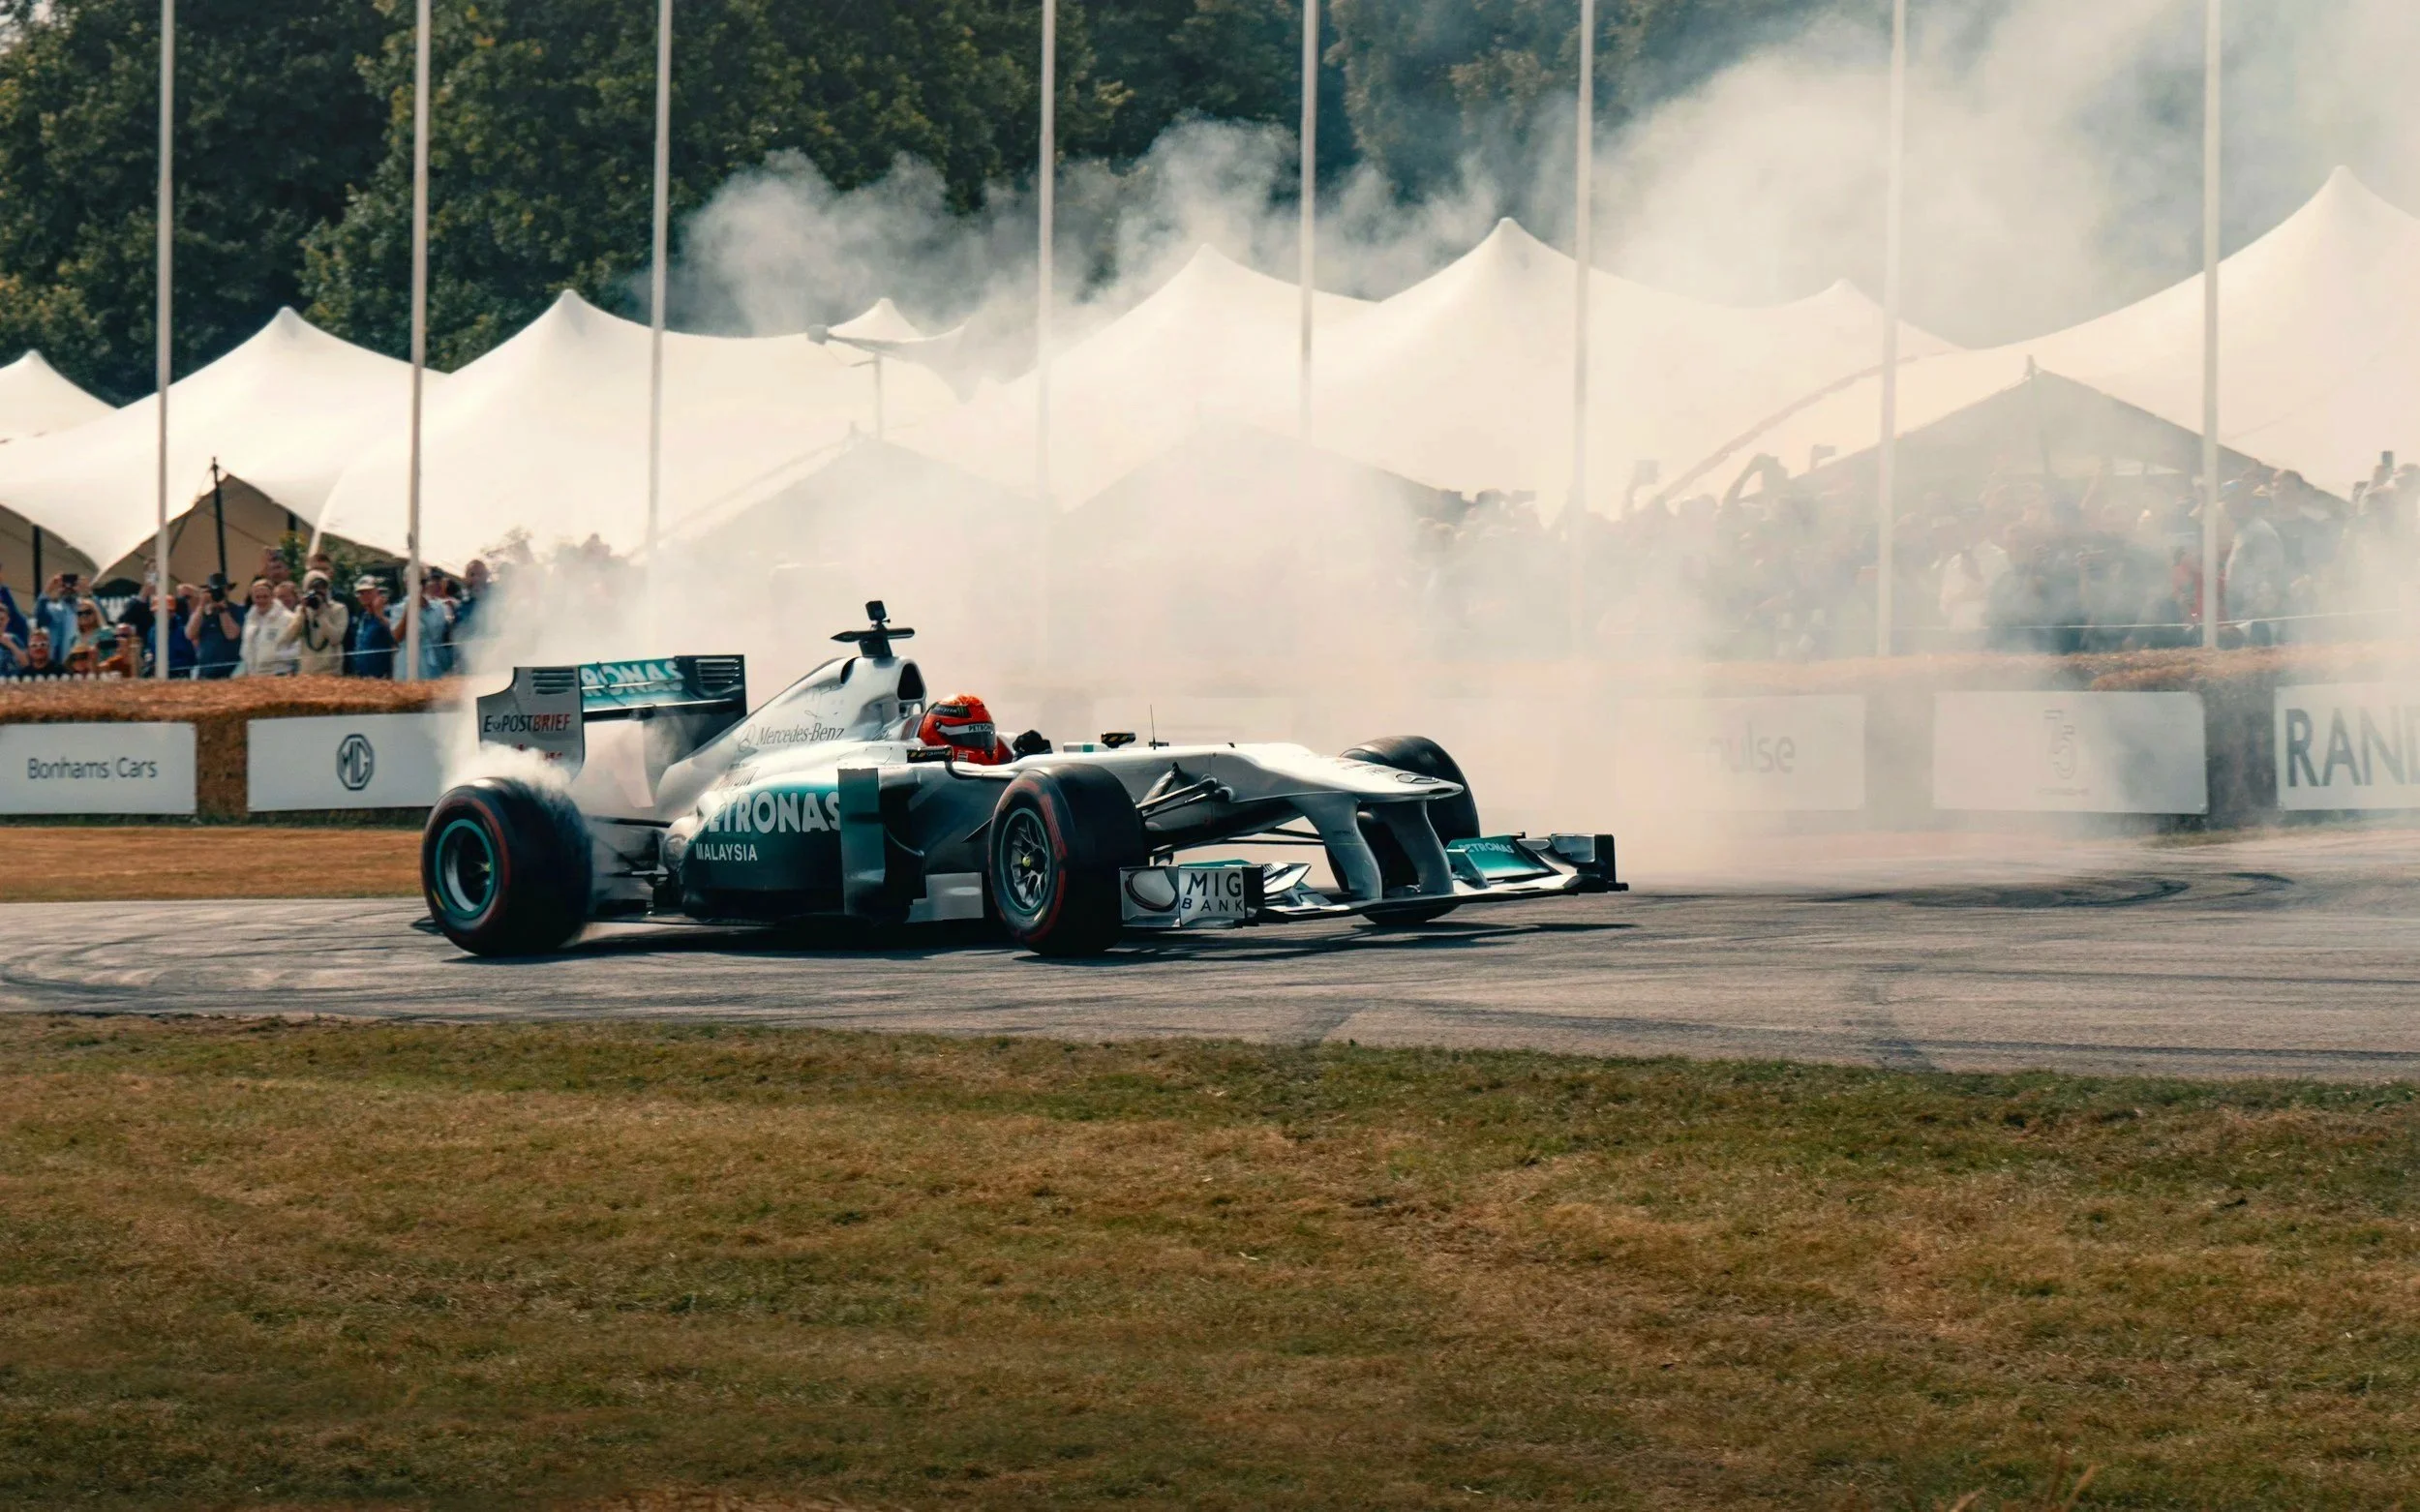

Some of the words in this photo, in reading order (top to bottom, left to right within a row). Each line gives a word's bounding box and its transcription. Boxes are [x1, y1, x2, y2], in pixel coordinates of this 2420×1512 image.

[755, 722, 845, 746] Mercedes-Benz
[28, 756, 110, 778] Bonhams
[117, 756, 158, 778] Cars
[696, 843, 758, 862] MALAYSIA
[1187, 872, 1242, 897] MIG
[1181, 897, 1243, 912] BANK
